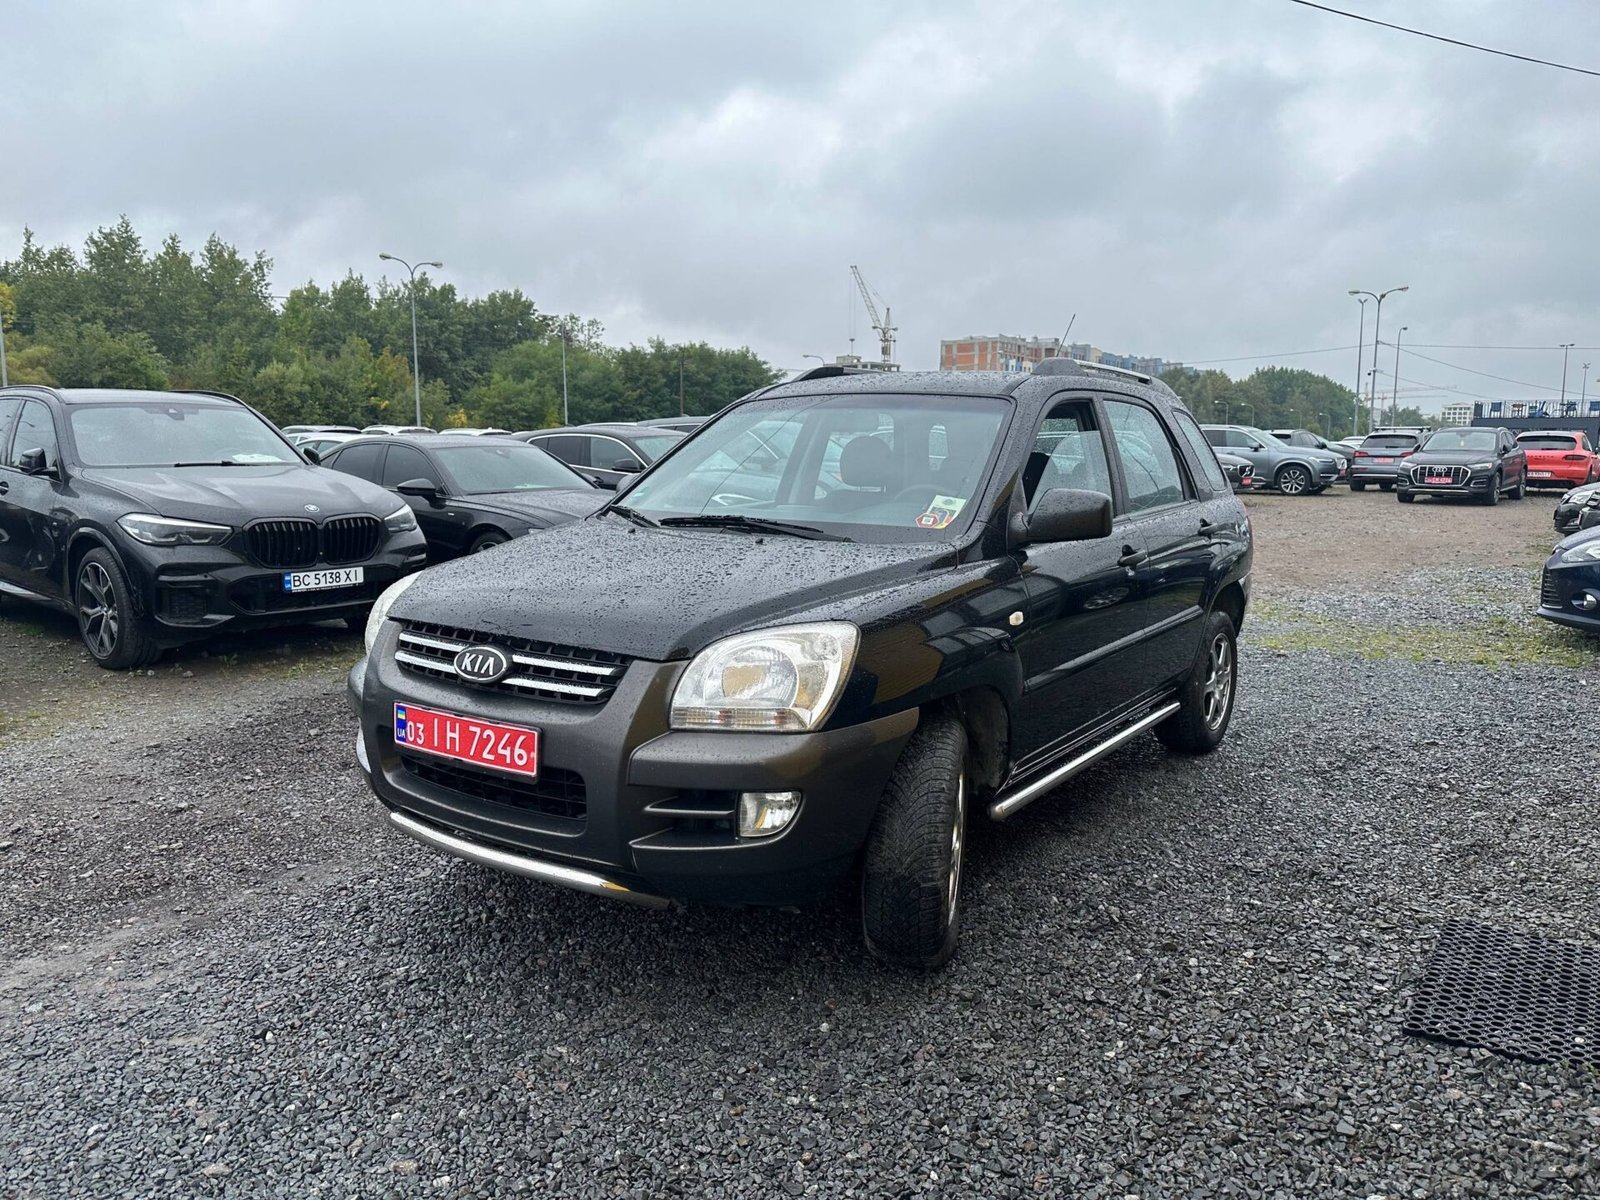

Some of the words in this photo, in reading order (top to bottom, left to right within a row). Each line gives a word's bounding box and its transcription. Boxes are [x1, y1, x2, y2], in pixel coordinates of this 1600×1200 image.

[292, 574, 311, 588] BC
[314, 571, 341, 586] 5138
[461, 652, 495, 676] KIA
[397, 727, 406, 739] UA
[407, 720, 425, 744] 03
[433, 717, 460, 752] IH
[468, 725, 528, 766] 7246
